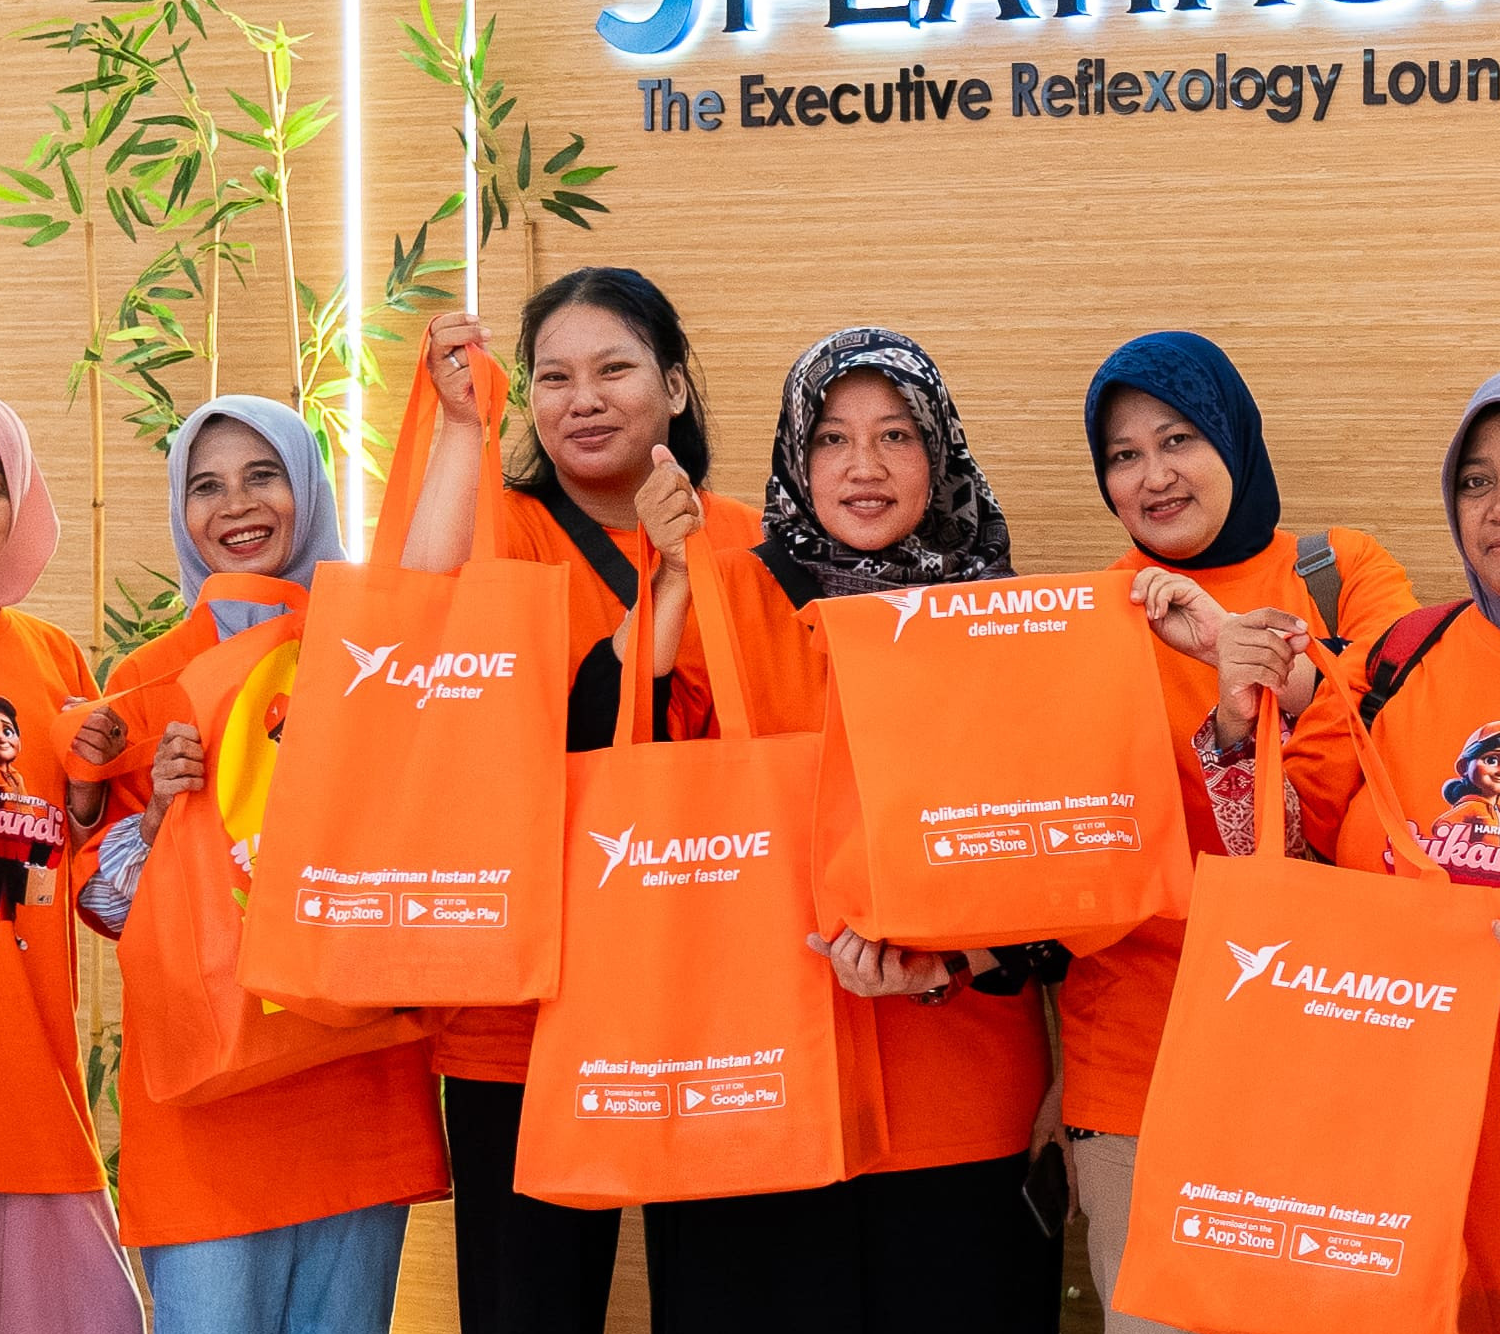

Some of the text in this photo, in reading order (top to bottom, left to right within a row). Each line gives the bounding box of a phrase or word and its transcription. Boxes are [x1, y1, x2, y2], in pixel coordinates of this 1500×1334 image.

[638, 78, 723, 133] The
[741, 66, 991, 128] Executive
[1012, 58, 1342, 123] Reflexology
[929, 587, 1095, 619] LALAMOVE
[968, 619, 1068, 637] deliver faster
[435, 684, 483, 699] faster
[920, 792, 1135, 825] Aplikasi Pengiriman Instan 24/7
[1008, 828, 1020, 836] the
[1075, 830, 1134, 845] Google Play
[1474, 825, 1500, 835] HARI
[629, 831, 771, 866] LALAMOVE
[959, 839, 1027, 856] App Store
[301, 866, 360, 885] Aplikasi
[431, 870, 476, 884] Instan
[478, 870, 511, 884] 24/7
[642, 869, 740, 887] deliver faster
[326, 906, 383, 922] App Store
[433, 907, 500, 922] Google Play
[1271, 961, 1457, 1012] LALAMOVE
[1304, 999, 1415, 1030] deliver faster
[579, 1059, 628, 1077] Aplikasi
[707, 1054, 751, 1069] Instan
[754, 1049, 785, 1065] 24/7
[604, 1098, 661, 1114] App Store
[711, 1090, 778, 1106] Google Play
[1180, 1182, 1412, 1230] Aplikasi Pengiriman Instan 24/7
[1248, 1223, 1258, 1231] on
[1260, 1224, 1273, 1233] the
[1205, 1227, 1275, 1250] App Store
[1325, 1246, 1394, 1269] Google Play
